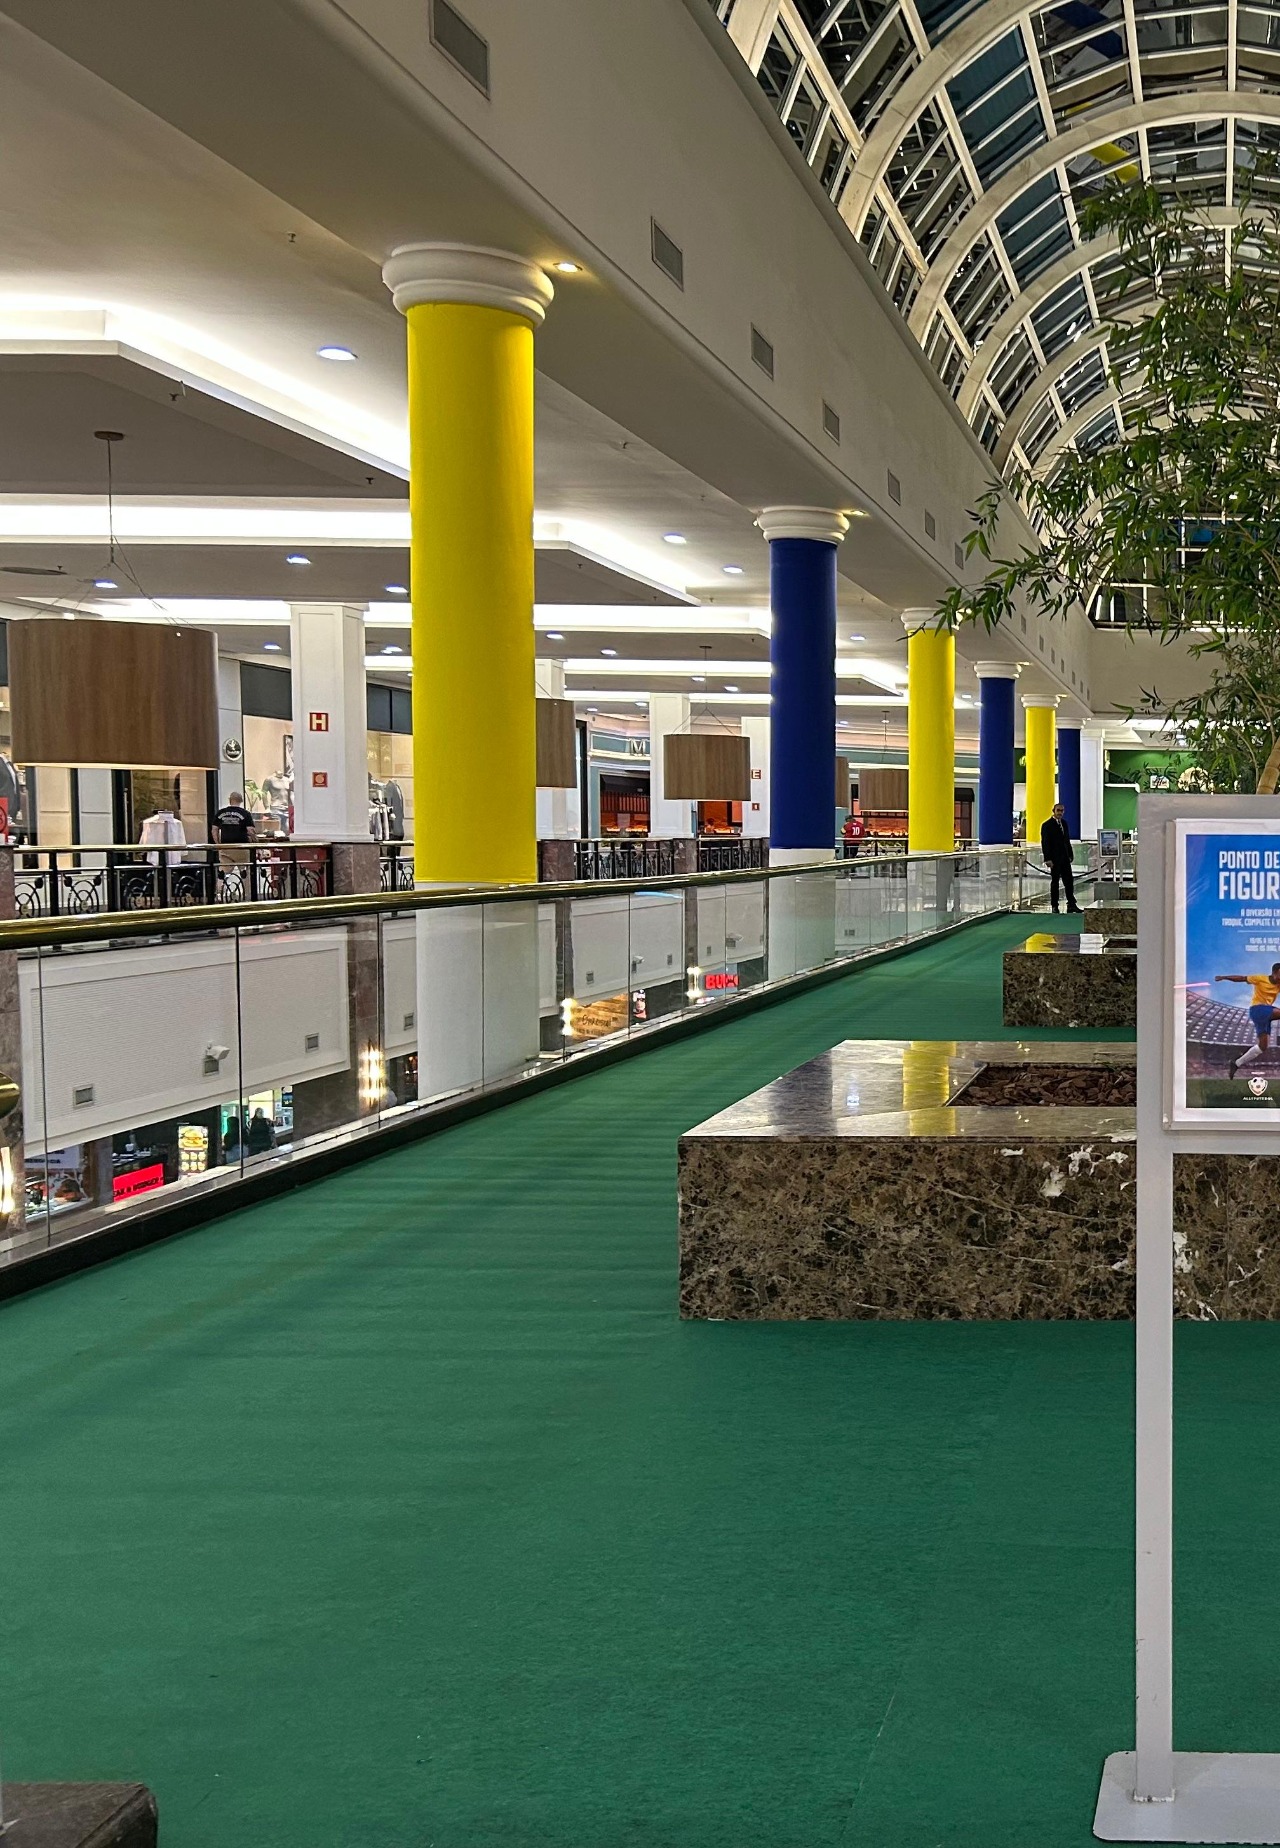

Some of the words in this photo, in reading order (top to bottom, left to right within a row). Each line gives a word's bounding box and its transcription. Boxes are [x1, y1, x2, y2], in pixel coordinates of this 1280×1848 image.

[311, 713, 326, 730] H
[1219, 851, 1260, 869] PONTO
[1264, 851, 1280, 869] DE
[1246, 908, 1272, 917] DIVERSÃO
